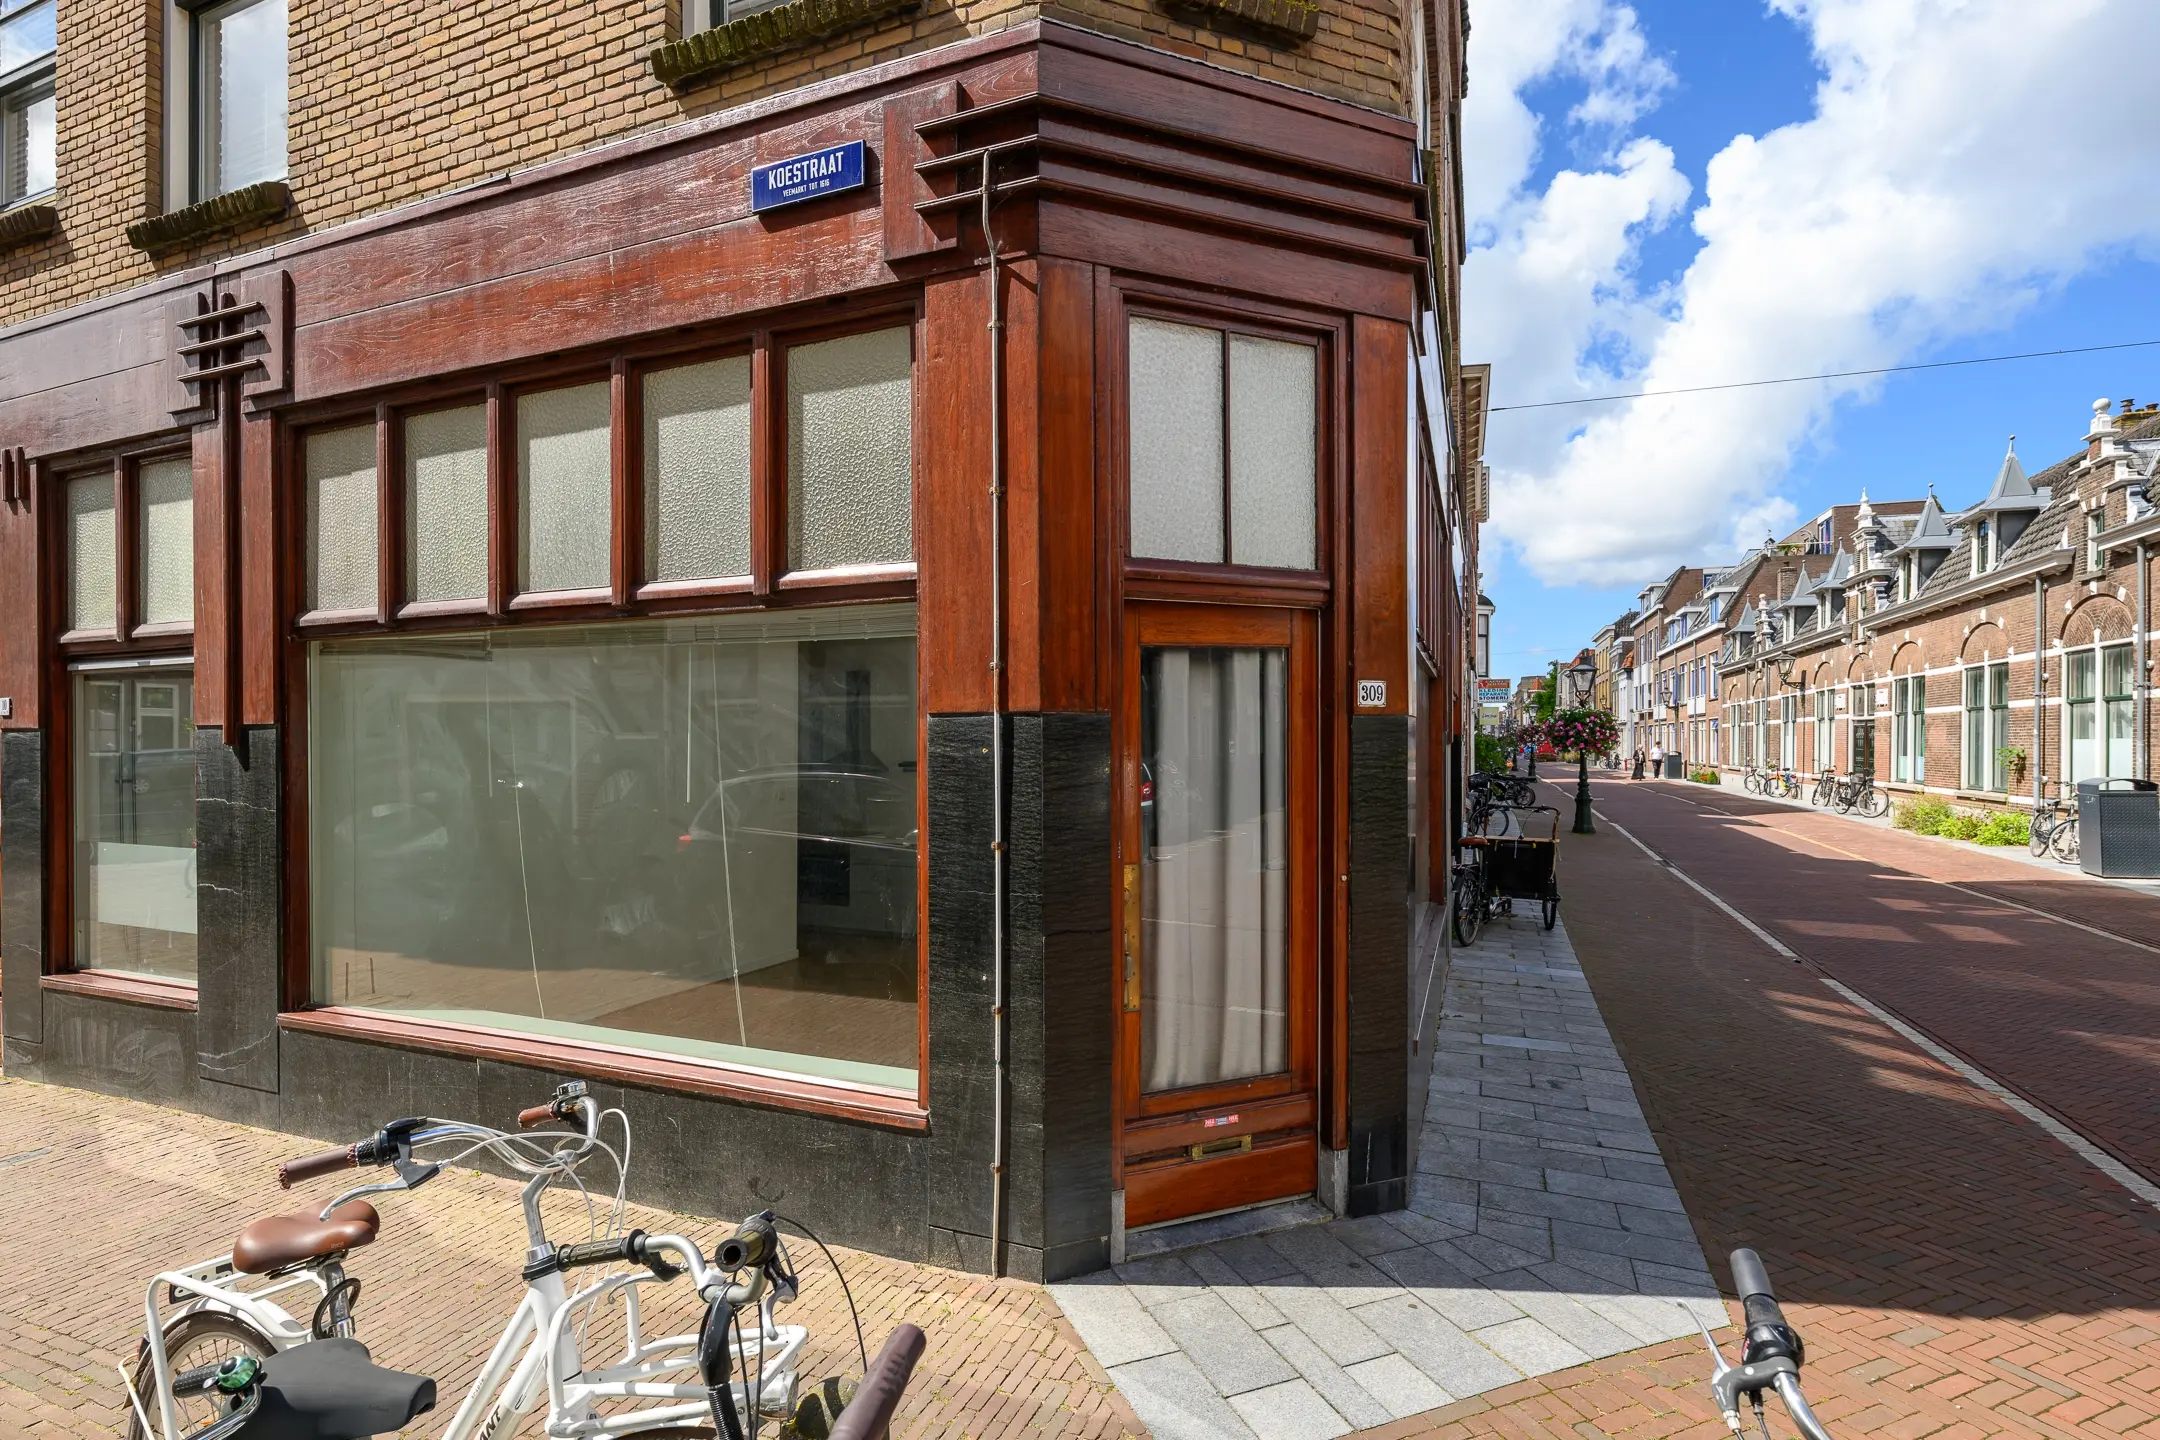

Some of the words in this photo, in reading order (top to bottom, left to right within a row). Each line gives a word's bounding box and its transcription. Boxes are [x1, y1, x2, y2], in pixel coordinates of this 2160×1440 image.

[768, 151, 844, 190] KOESTRAAT
[782, 184, 807, 198] VEEMARKT
[809, 181, 818, 191] TOT
[1361, 685, 1384, 701] 309
